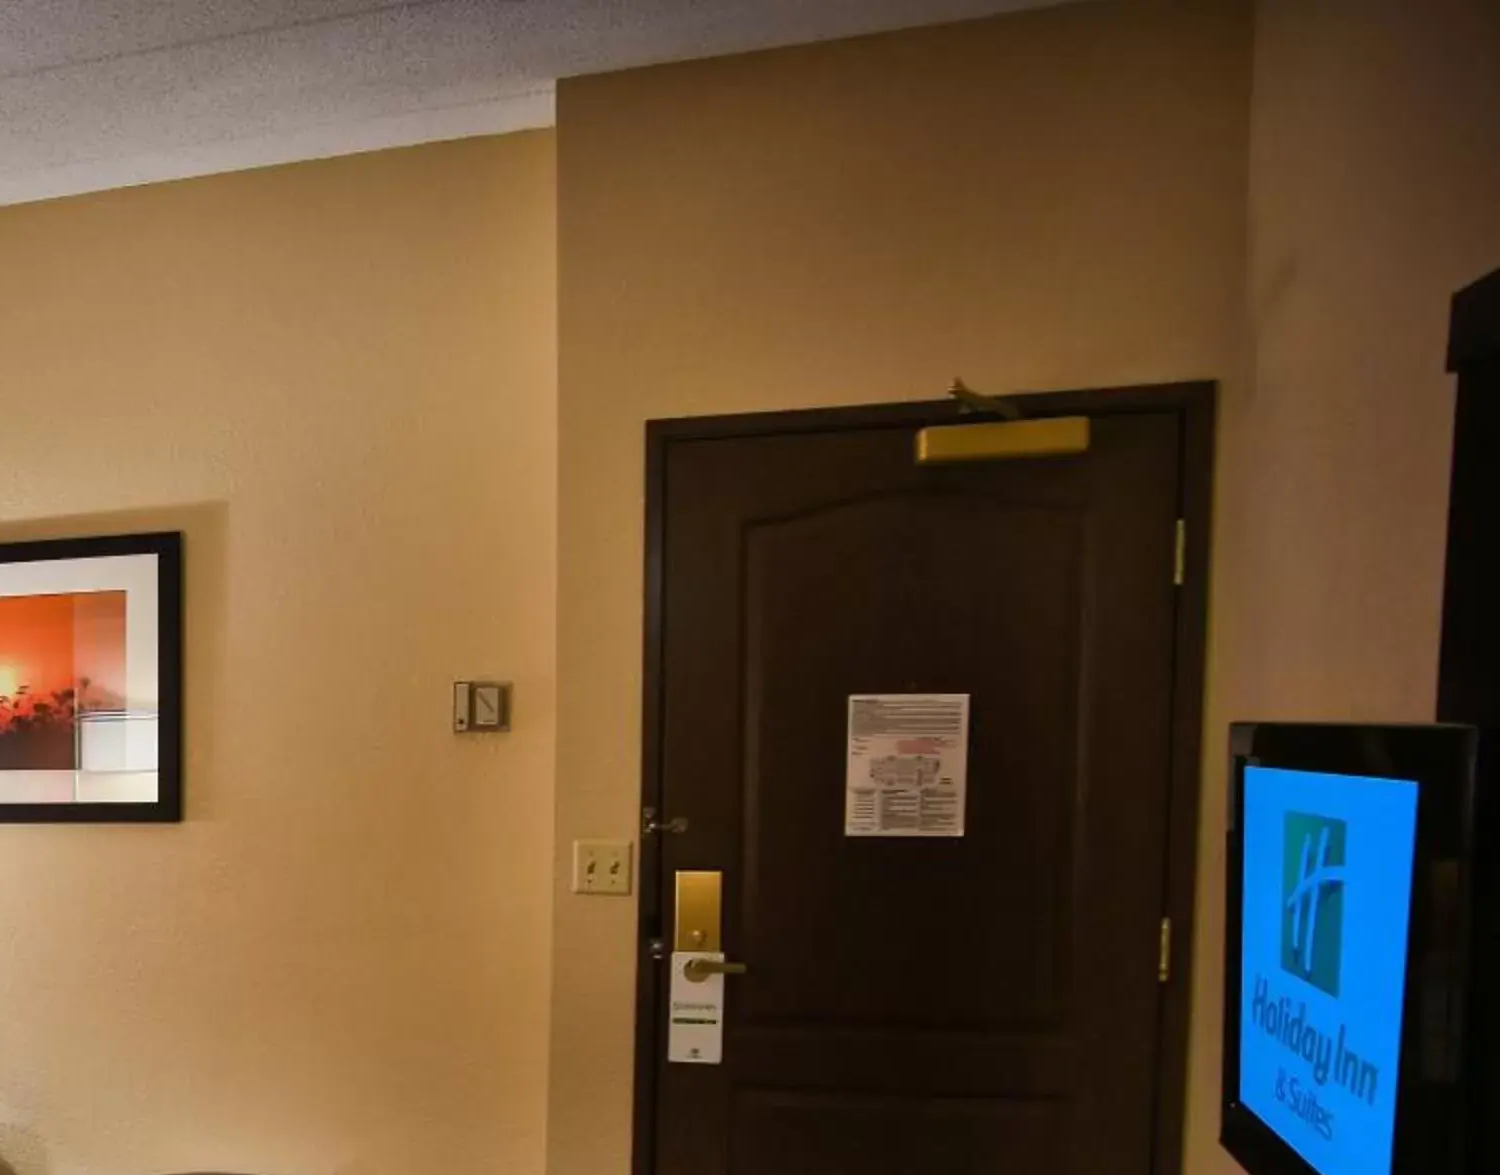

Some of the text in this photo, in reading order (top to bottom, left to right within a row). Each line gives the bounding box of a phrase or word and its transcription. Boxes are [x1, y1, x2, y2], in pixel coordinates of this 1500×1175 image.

[1252, 973, 1379, 1107] Holiday Inn
[1288, 1076, 1334, 1141] Suites
